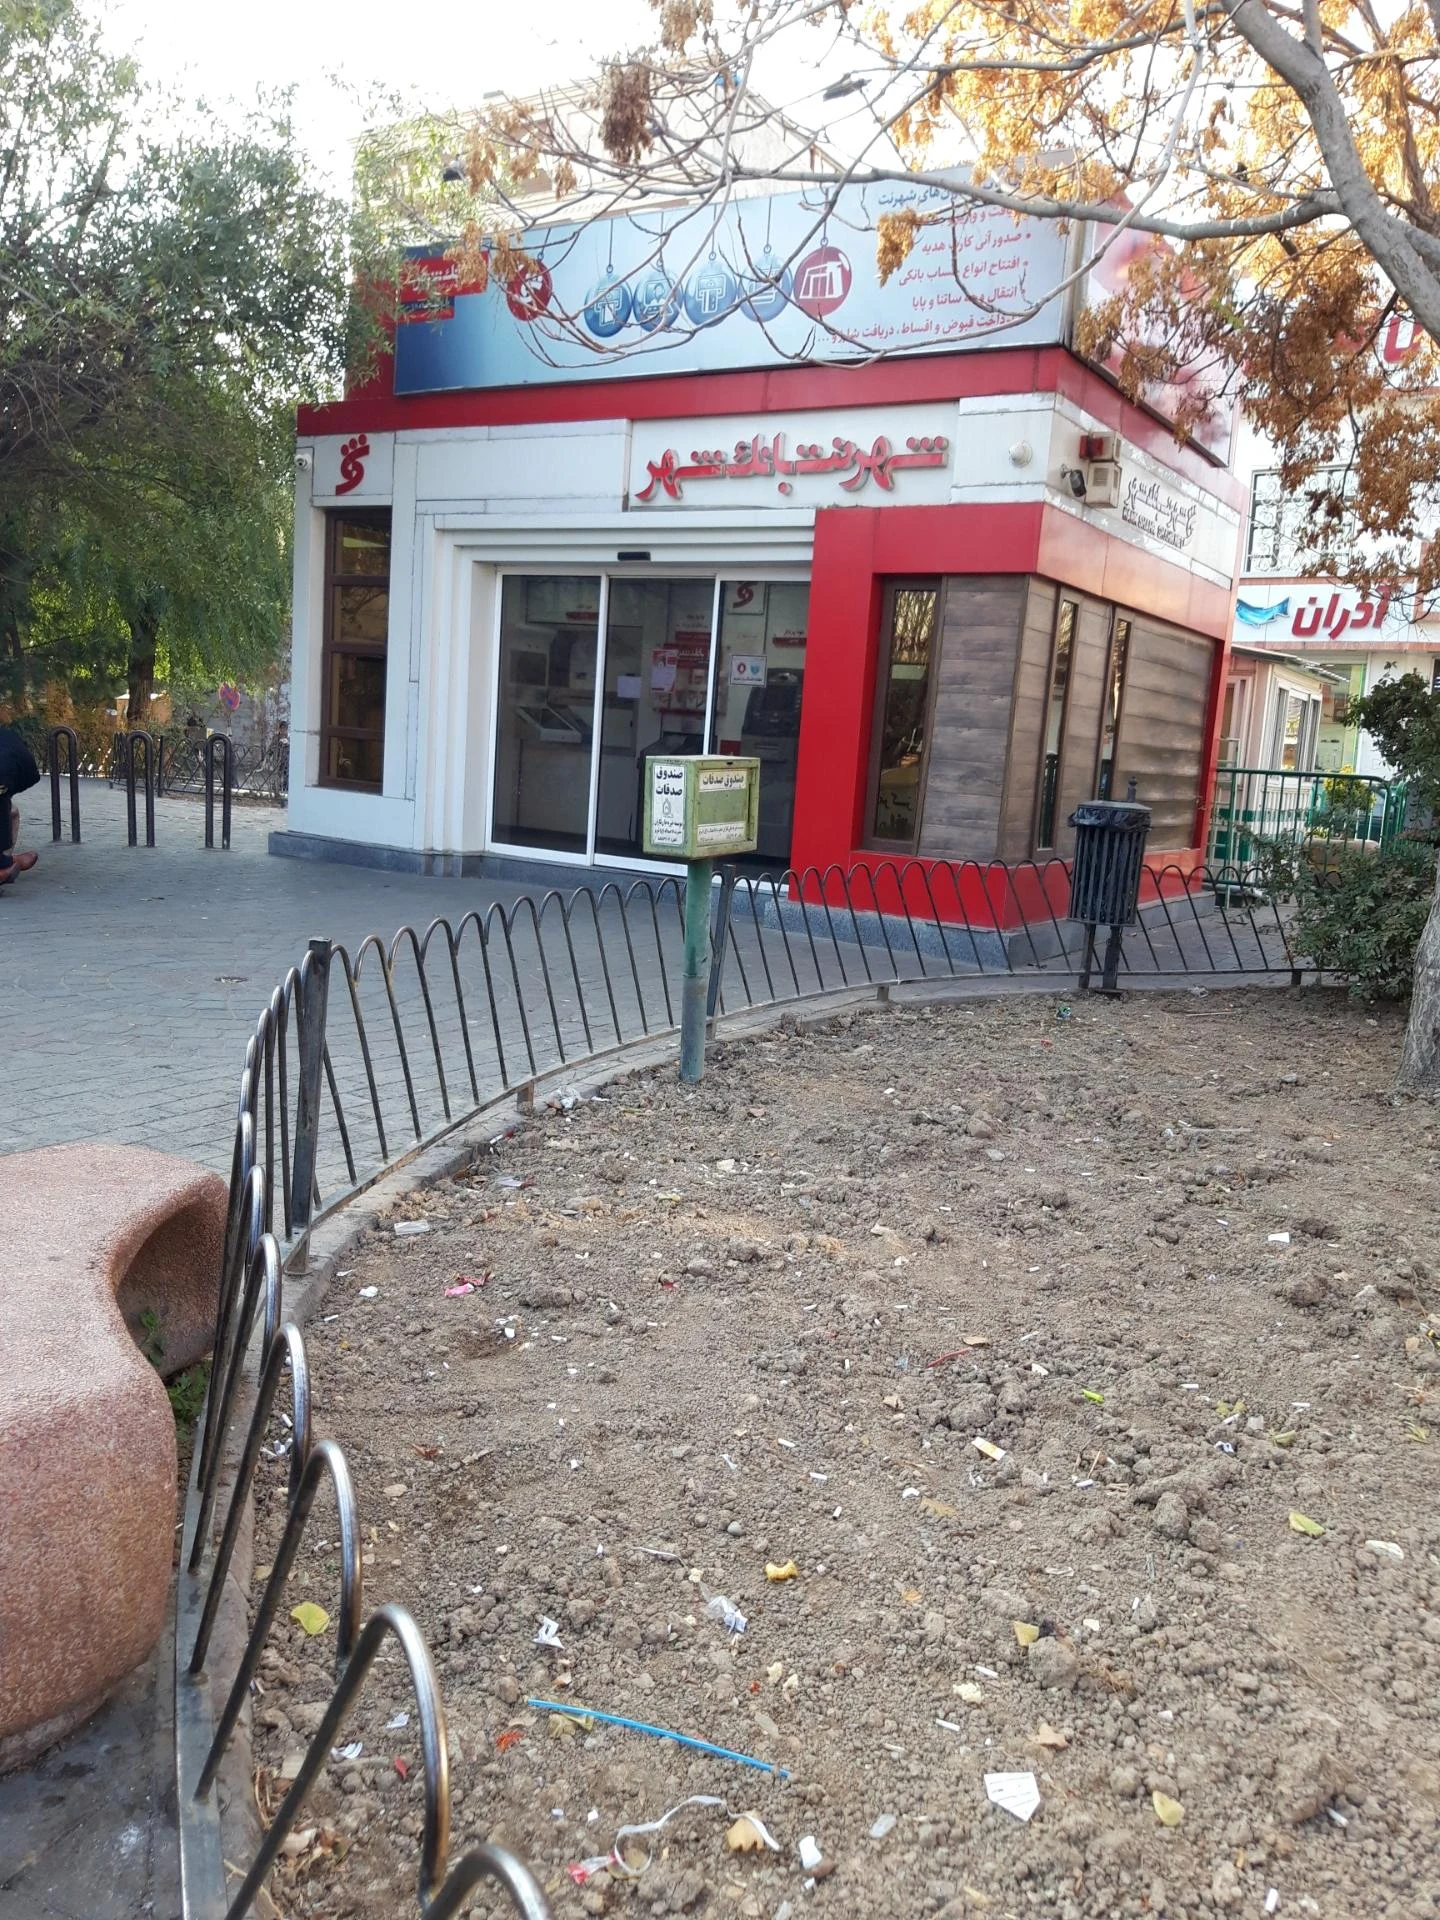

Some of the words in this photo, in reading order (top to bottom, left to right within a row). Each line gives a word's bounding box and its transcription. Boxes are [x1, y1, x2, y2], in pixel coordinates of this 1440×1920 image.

[921, 241, 946, 255] هدیه
[992, 232, 1022, 248] صدور
[962, 261, 987, 279] انواع
[988, 256, 1020, 276] افتتاح
[899, 269, 925, 286] بانکی
[936, 292, 962, 305] ساتنا
[987, 286, 1017, 303] انتقال
[862, 323, 894, 339] دریافت
[942, 314, 975, 334] قبوض
[727, 431, 796, 497] بانک
[795, 435, 949, 493] شهرنت
[635, 447, 726, 501] شهر
[656, 766, 683, 780] صندوق
[702, 772, 723, 785] صدقات
[655, 783, 683, 796] صدقات
[723, 775, 744, 788] صندوق
